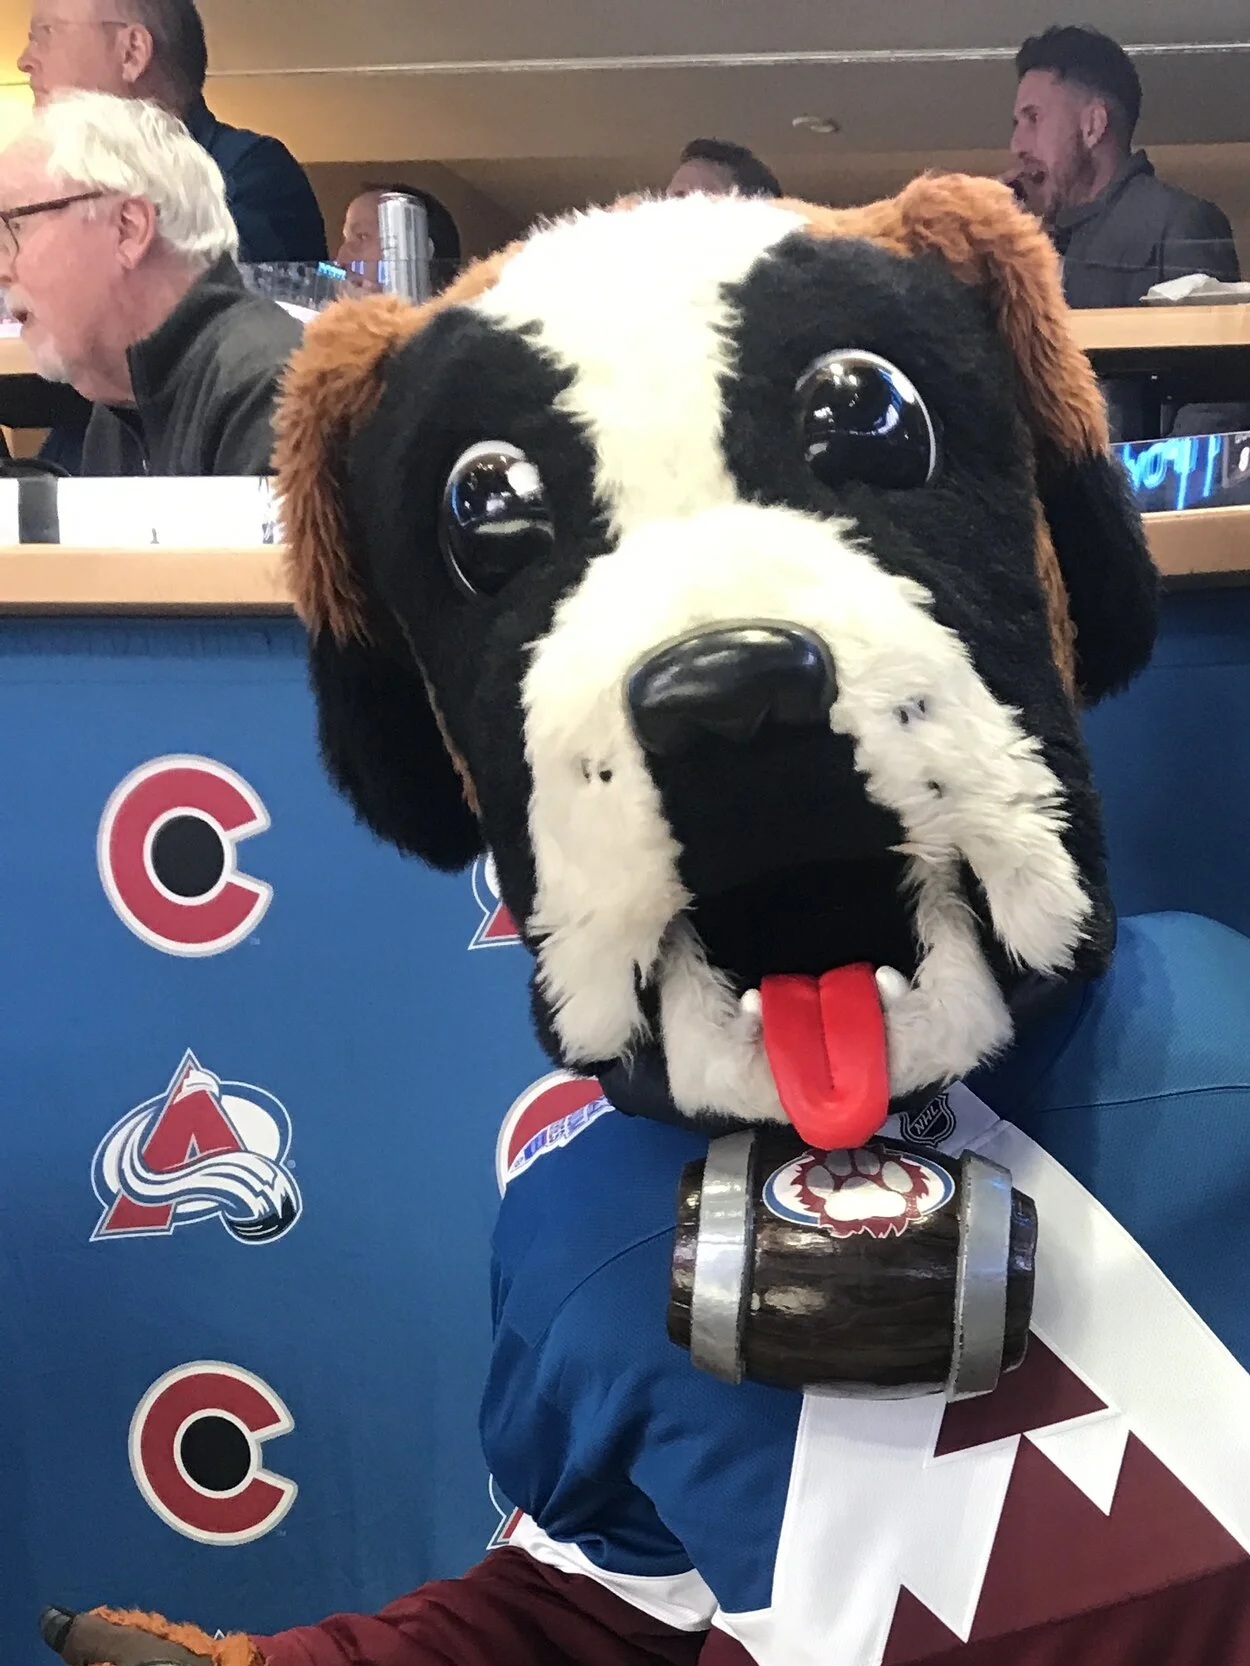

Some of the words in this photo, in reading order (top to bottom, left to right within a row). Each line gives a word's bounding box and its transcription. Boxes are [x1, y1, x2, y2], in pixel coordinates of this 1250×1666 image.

[97, 754, 274, 958] C
[914, 1105, 939, 1135] NHL
[128, 1360, 298, 1546] C
